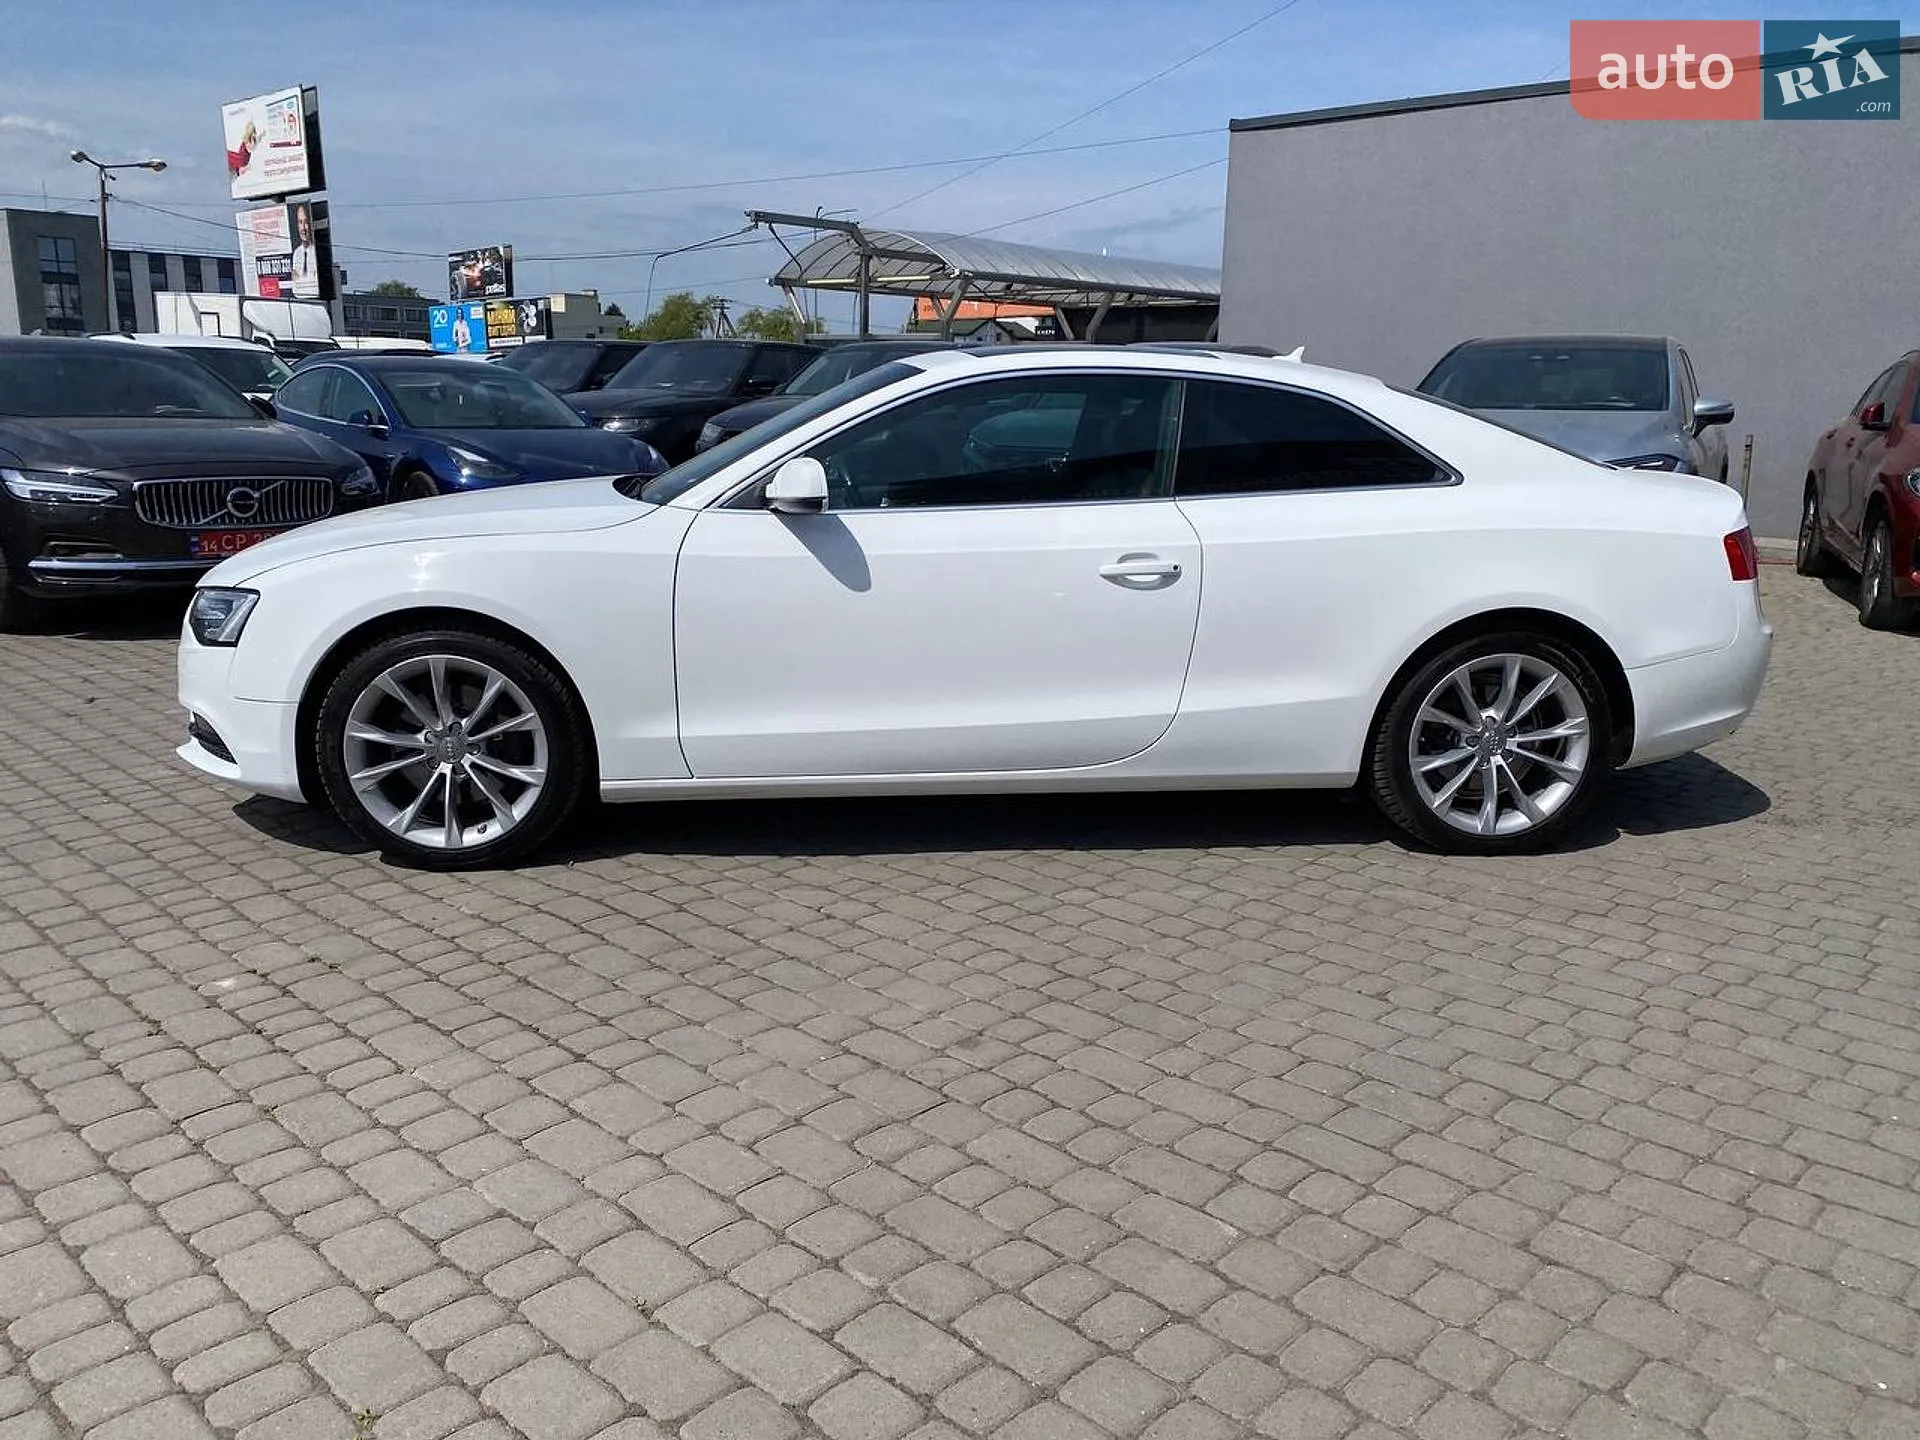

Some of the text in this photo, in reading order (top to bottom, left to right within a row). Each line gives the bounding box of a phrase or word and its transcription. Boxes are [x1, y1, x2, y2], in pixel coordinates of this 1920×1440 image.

[433, 309, 448, 324] 20
[201, 540, 218, 552] 14
[222, 534, 246, 550] CP
